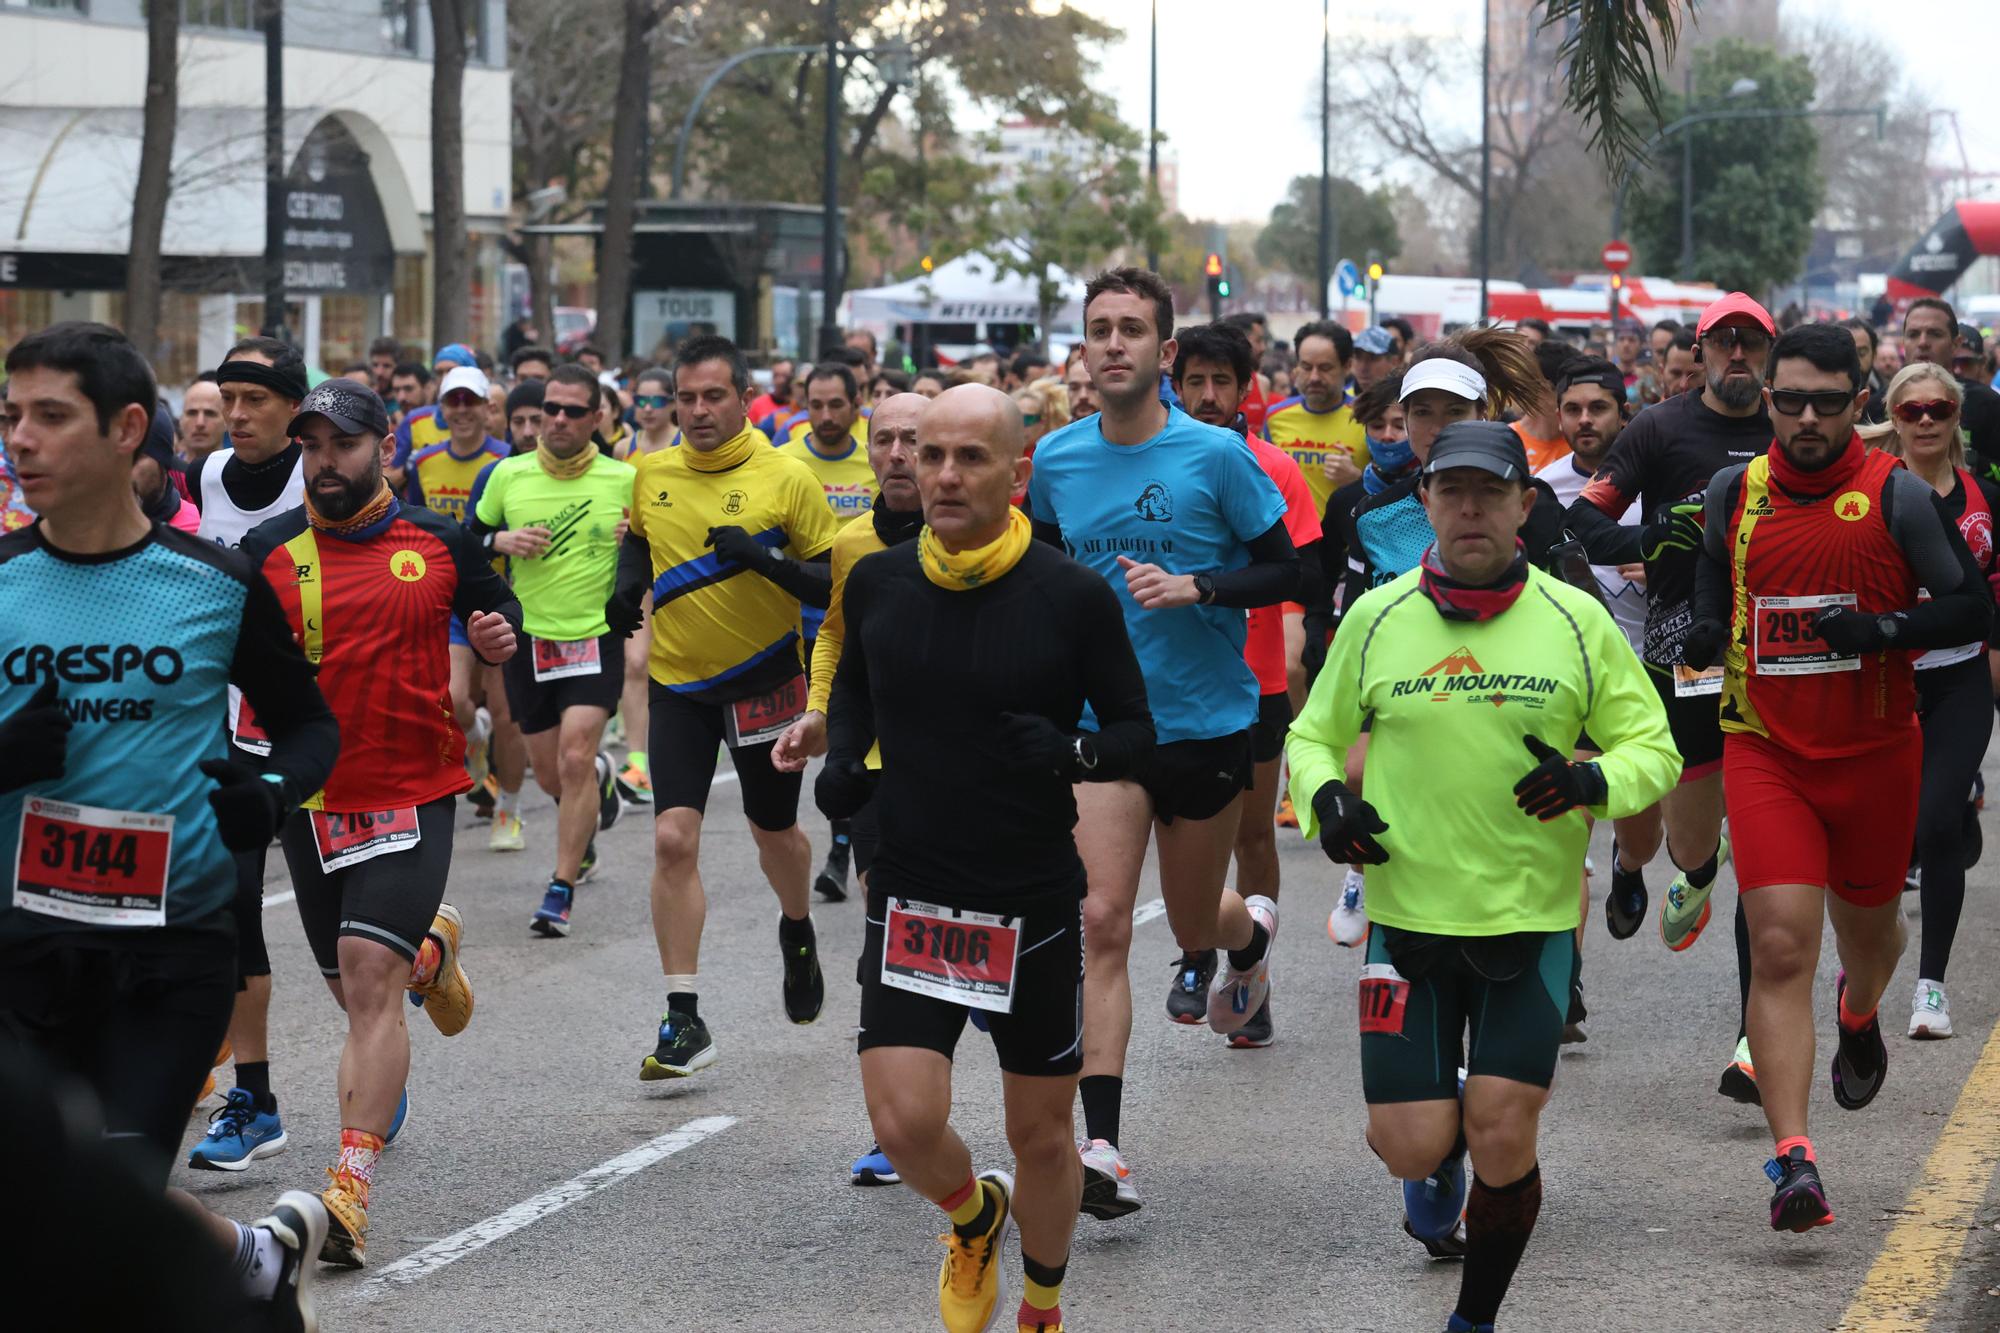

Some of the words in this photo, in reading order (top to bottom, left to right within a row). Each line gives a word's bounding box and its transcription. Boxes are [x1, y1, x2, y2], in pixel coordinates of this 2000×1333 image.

[658, 298, 713, 317] TOUS
[1746, 508, 1775, 516] VIATOR
[1766, 610, 1818, 643] 293
[3, 645, 184, 686] CRESPO
[1391, 677, 1436, 698] RUN
[1443, 674, 1559, 694] MOUNTAIN
[56, 697, 155, 723] NNERS
[41, 824, 138, 878] 3144
[904, 919, 991, 966] 3106
